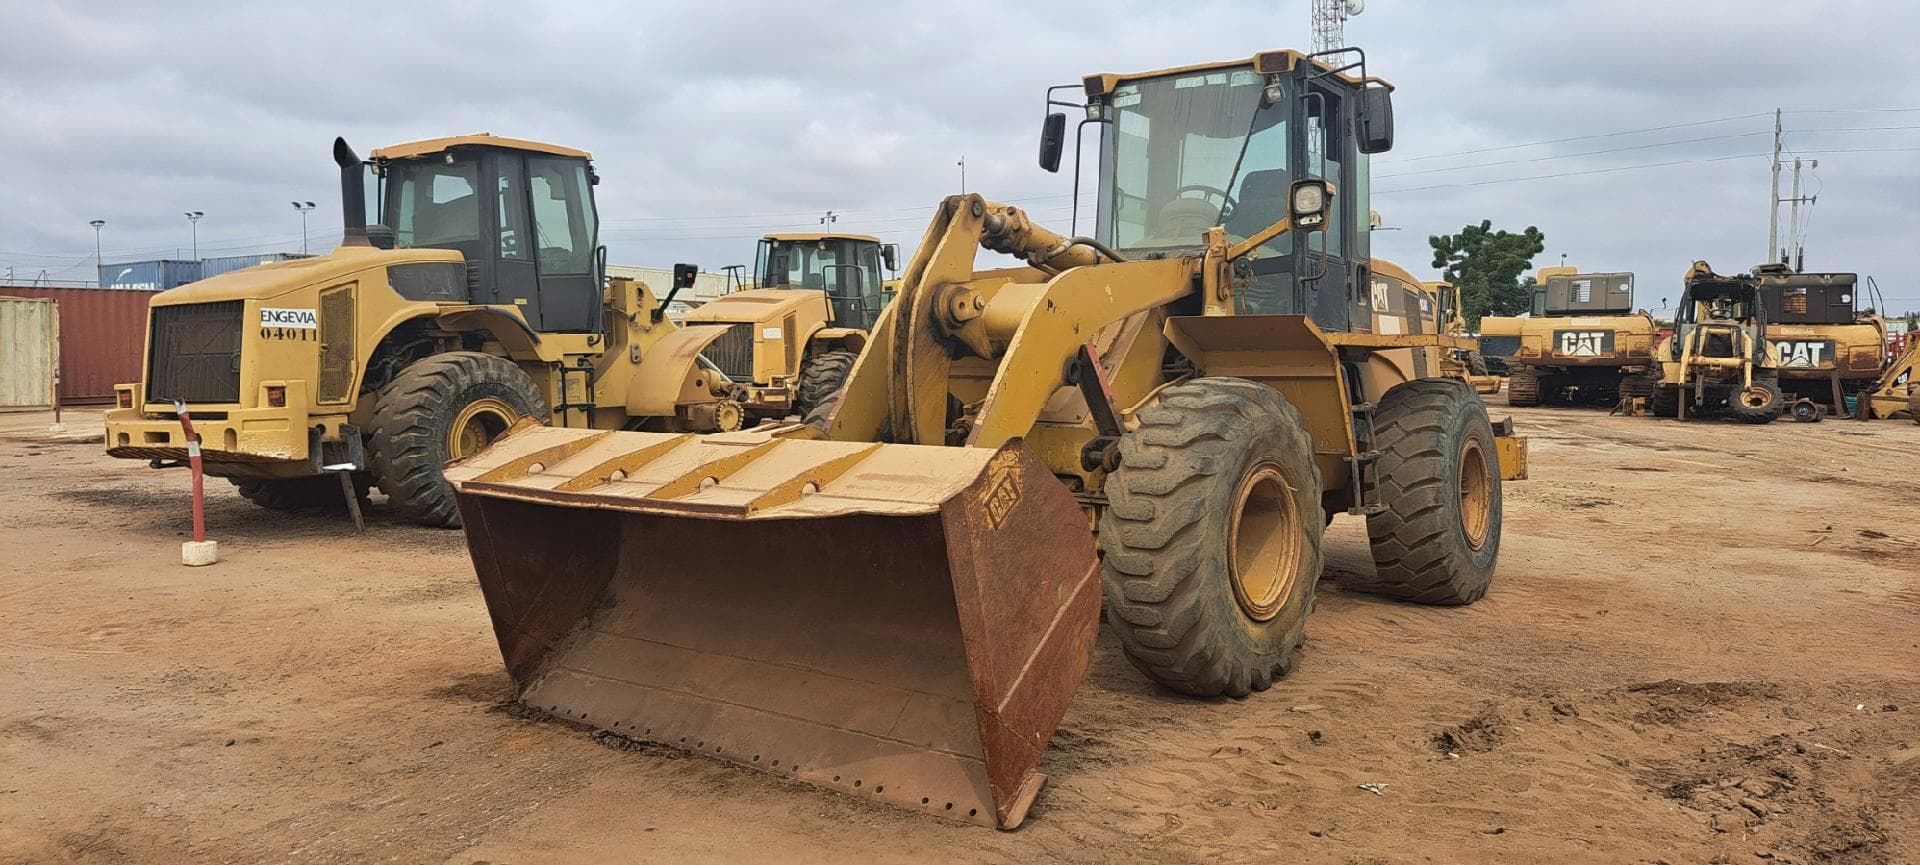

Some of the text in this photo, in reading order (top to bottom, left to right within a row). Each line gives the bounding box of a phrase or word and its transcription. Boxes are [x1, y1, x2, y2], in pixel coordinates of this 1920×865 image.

[1370, 280, 1389, 312] CAT
[260, 310, 316, 324] ENGEVIA
[1562, 332, 1605, 357] CAT
[1776, 341, 1825, 368] CAT
